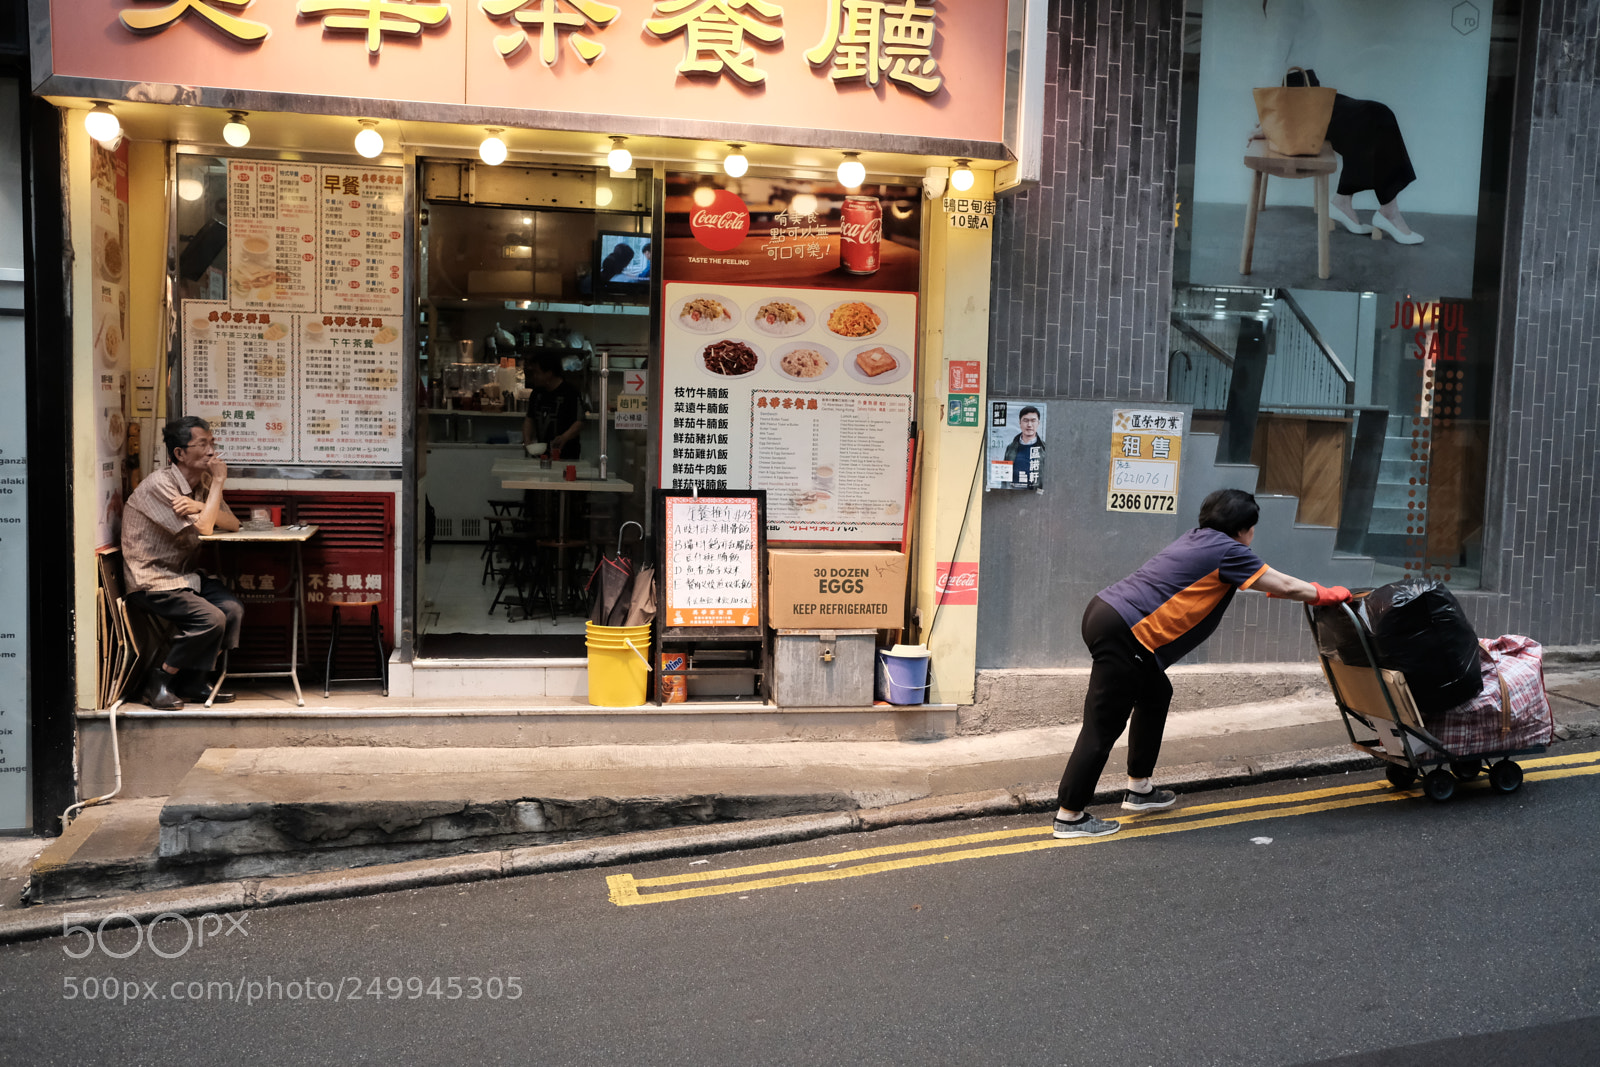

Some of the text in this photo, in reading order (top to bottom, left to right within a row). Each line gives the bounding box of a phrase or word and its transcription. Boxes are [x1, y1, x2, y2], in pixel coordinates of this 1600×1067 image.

[324, 175, 359, 195] 早餐
[943, 199, 995, 215] 鴨巴甸街
[692, 209, 748, 230] Coca-Cola
[950, 214, 989, 229] 10號A
[688, 256, 750, 266] TASTE THE FEELING
[1390, 301, 1469, 332] JOYFUL
[330, 338, 374, 348] 下午茶餐
[1414, 331, 1469, 361] SALE
[674, 387, 729, 399] 枝竹牛腩飯
[674, 402, 729, 414] 菜遠牛腩飯
[222, 410, 255, 420] 快趣餐
[265, 422, 283, 431] $35
[673, 417, 728, 429] 鮮茄牛腩飯
[673, 433, 728, 445] 鮮茄豬扒飯
[1122, 435, 1170, 459] 租售
[673, 448, 728, 460] 鮮茄雞扒飯
[672, 463, 727, 475] 鮮茄牛肉飯
[0, 478, 25, 486] alaki
[1116, 472, 1168, 488] 62210761
[1111, 494, 1174, 511] 2366 0772
[814, 569, 869, 578] 30 DOZEN
[819, 579, 864, 594] EGGS
[307, 592, 324, 603] NO
[793, 604, 888, 615] KEEP REFRIGERATED
